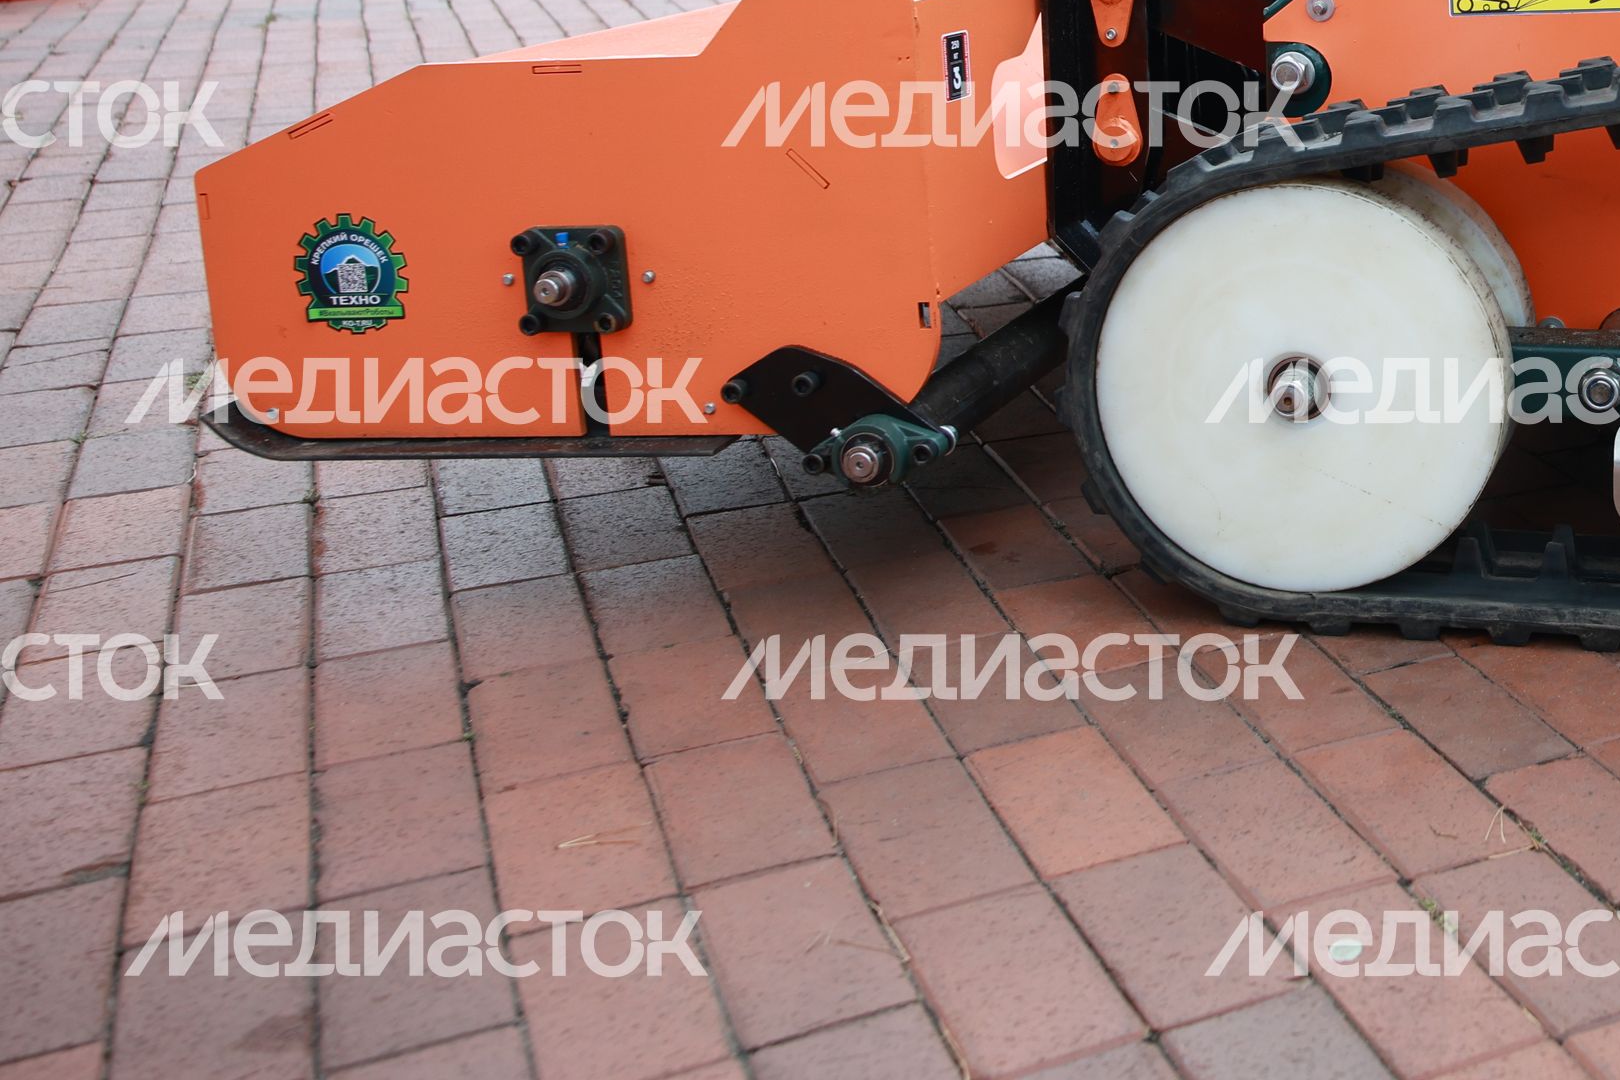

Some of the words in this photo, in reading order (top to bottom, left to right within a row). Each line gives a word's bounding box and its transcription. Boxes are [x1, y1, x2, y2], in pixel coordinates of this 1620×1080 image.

[310, 231, 348, 266] КРЕПКИЙ
[349, 233, 389, 264] ОРЕШЕК
[329, 295, 381, 306] ТЕХНО
